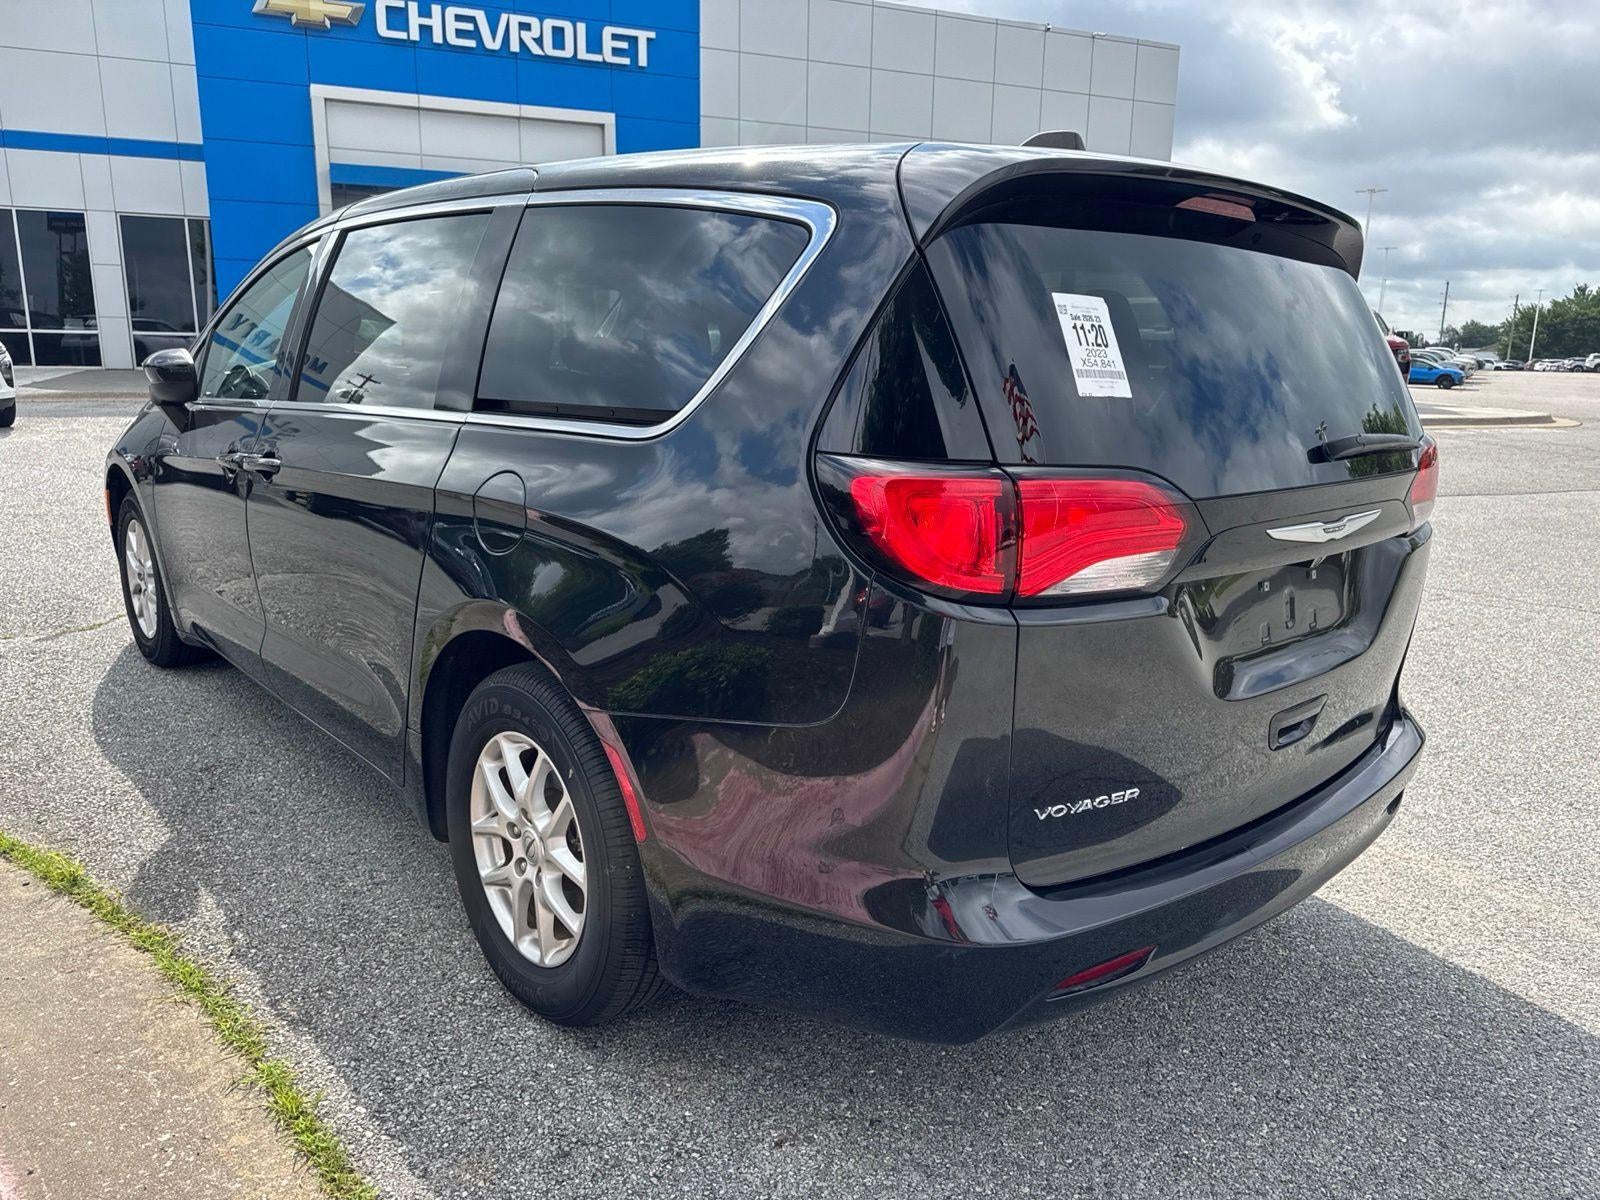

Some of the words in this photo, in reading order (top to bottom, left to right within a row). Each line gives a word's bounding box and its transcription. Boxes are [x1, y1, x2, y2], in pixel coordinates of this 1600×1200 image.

[375, 0, 656, 67] CHEVROLET
[1072, 322, 1109, 348] 11:20
[1085, 348, 1108, 358] 2023
[1034, 787, 1140, 821] VOYAGER
